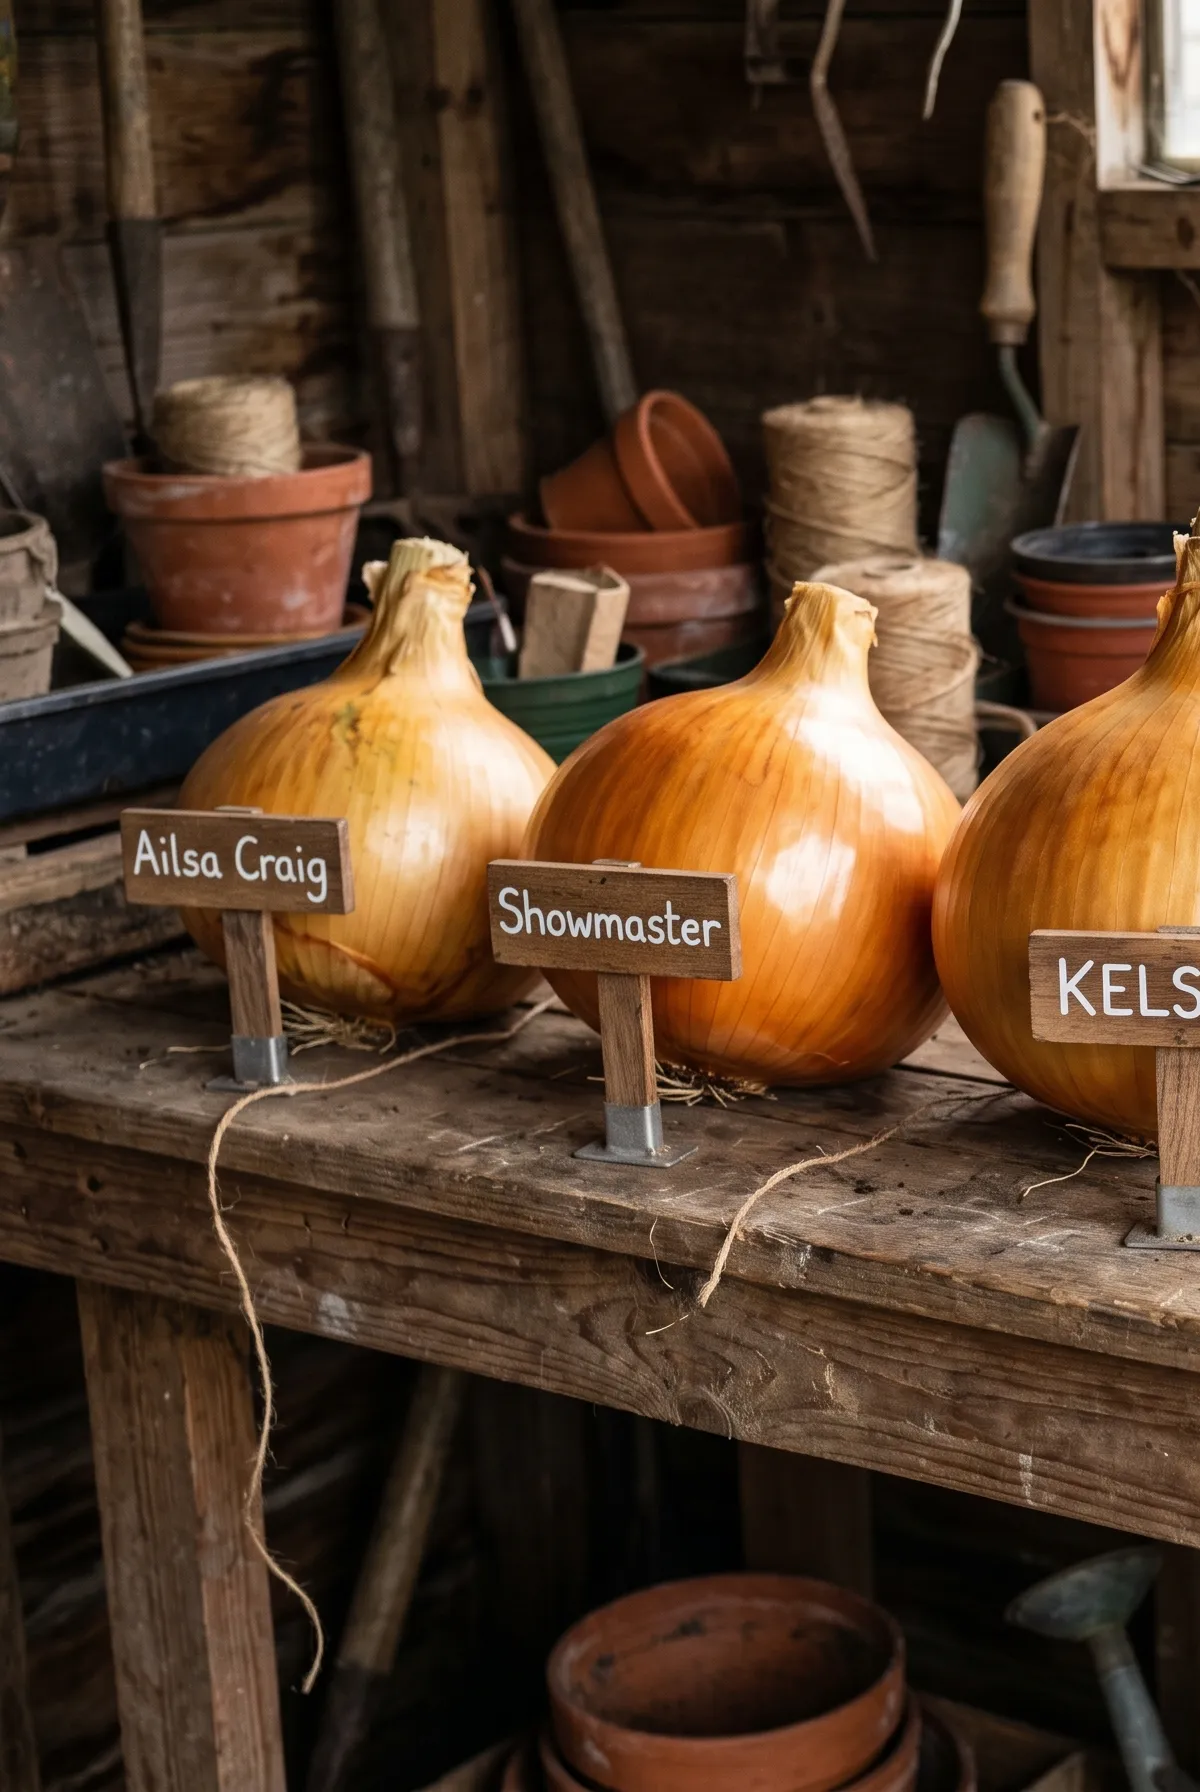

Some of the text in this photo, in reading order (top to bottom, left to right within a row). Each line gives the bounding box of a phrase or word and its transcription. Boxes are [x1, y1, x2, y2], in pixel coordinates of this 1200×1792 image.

[134, 829, 328, 903] Ailsa Craig
[498, 887, 722, 947] Showmaster
